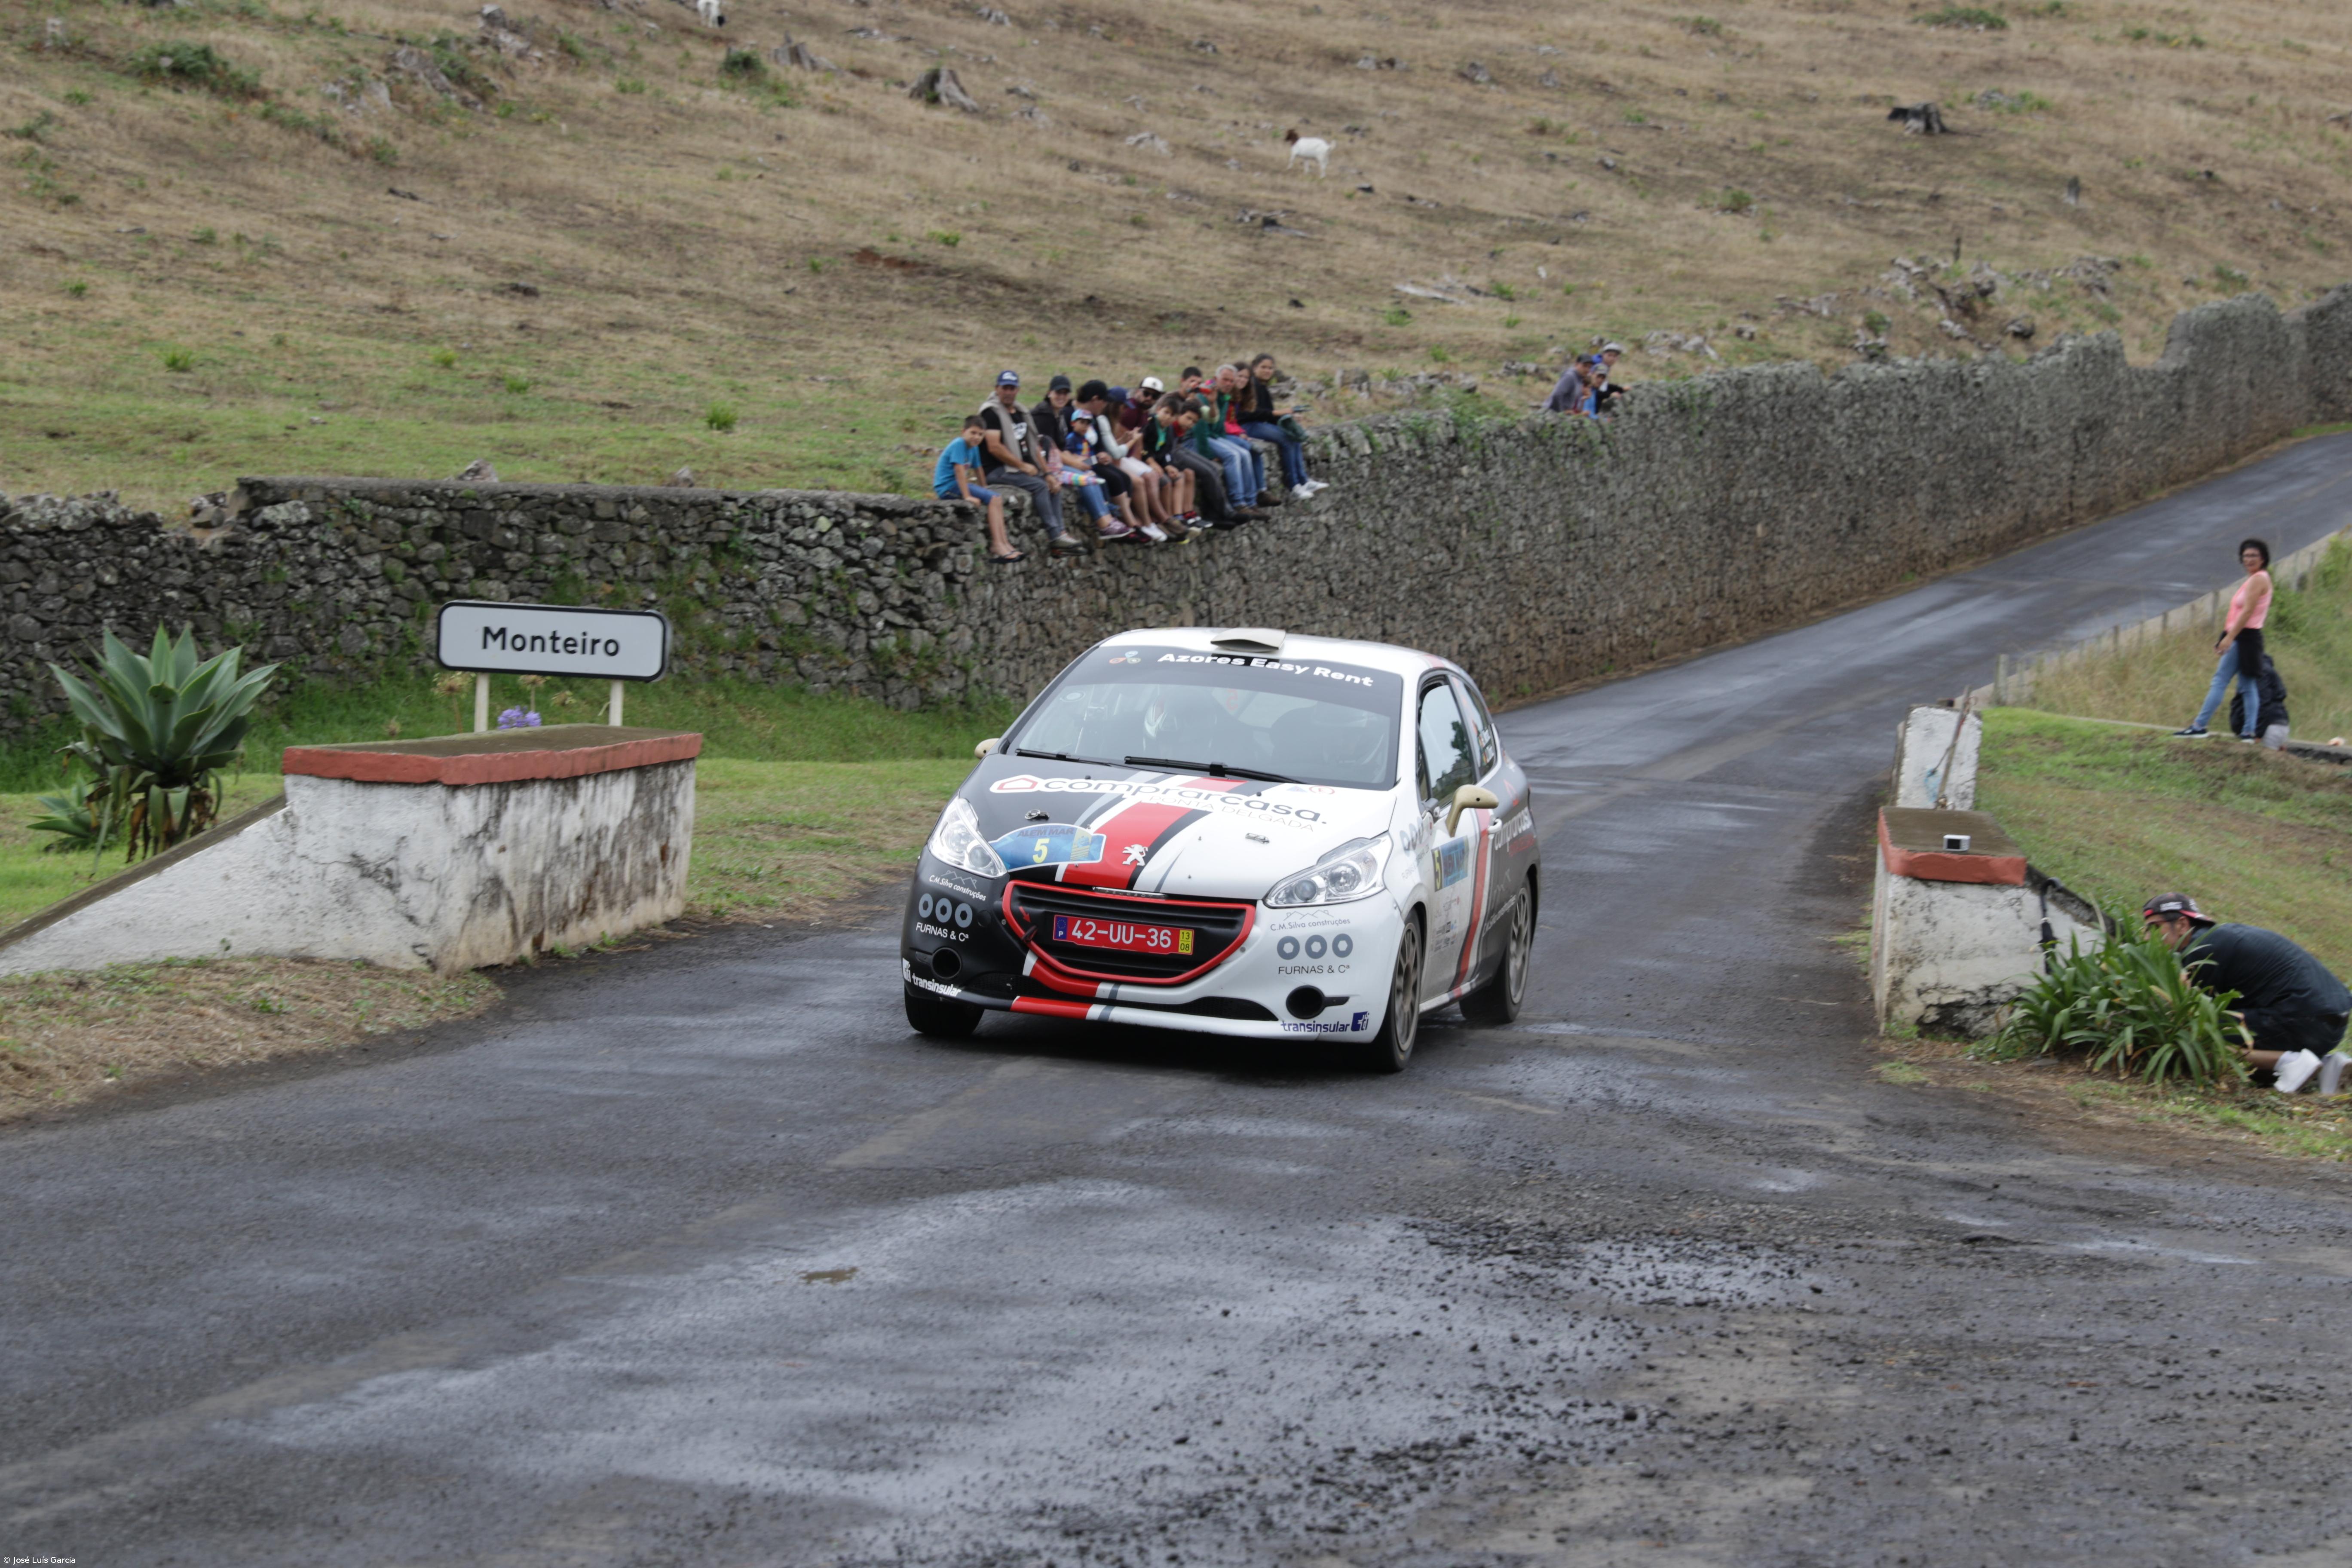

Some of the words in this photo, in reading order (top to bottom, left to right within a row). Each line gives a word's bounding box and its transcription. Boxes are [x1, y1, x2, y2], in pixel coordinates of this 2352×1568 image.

[482, 626, 619, 656] Monteiro
[1157, 653, 1245, 666] Azores
[1250, 658, 1310, 674] Easy
[1313, 666, 1374, 686] Rent
[1149, 796, 1214, 810] PONTA
[1222, 806, 1314, 832] DELGADA
[1048, 827, 1075, 836] MAR
[1032, 838, 1050, 864] 5
[1433, 849, 1440, 890] 5
[929, 875, 953, 888] C.M.Silva
[953, 884, 986, 901] construções
[916, 922, 948, 938] FURNAS
[950, 931, 956, 940] &
[1072, 920, 1171, 948] 42-UU-36
[1181, 931, 1190, 940] 13
[1270, 922, 1306, 931] C.M.Silva
[1308, 918, 1351, 926] construções
[1180, 942, 1190, 951] 08
[1278, 965, 1323, 975] FURNAS
[1327, 965, 1335, 974] &
[912, 973, 962, 997] transinsular
[1280, 1020, 1350, 1032] transinsular
